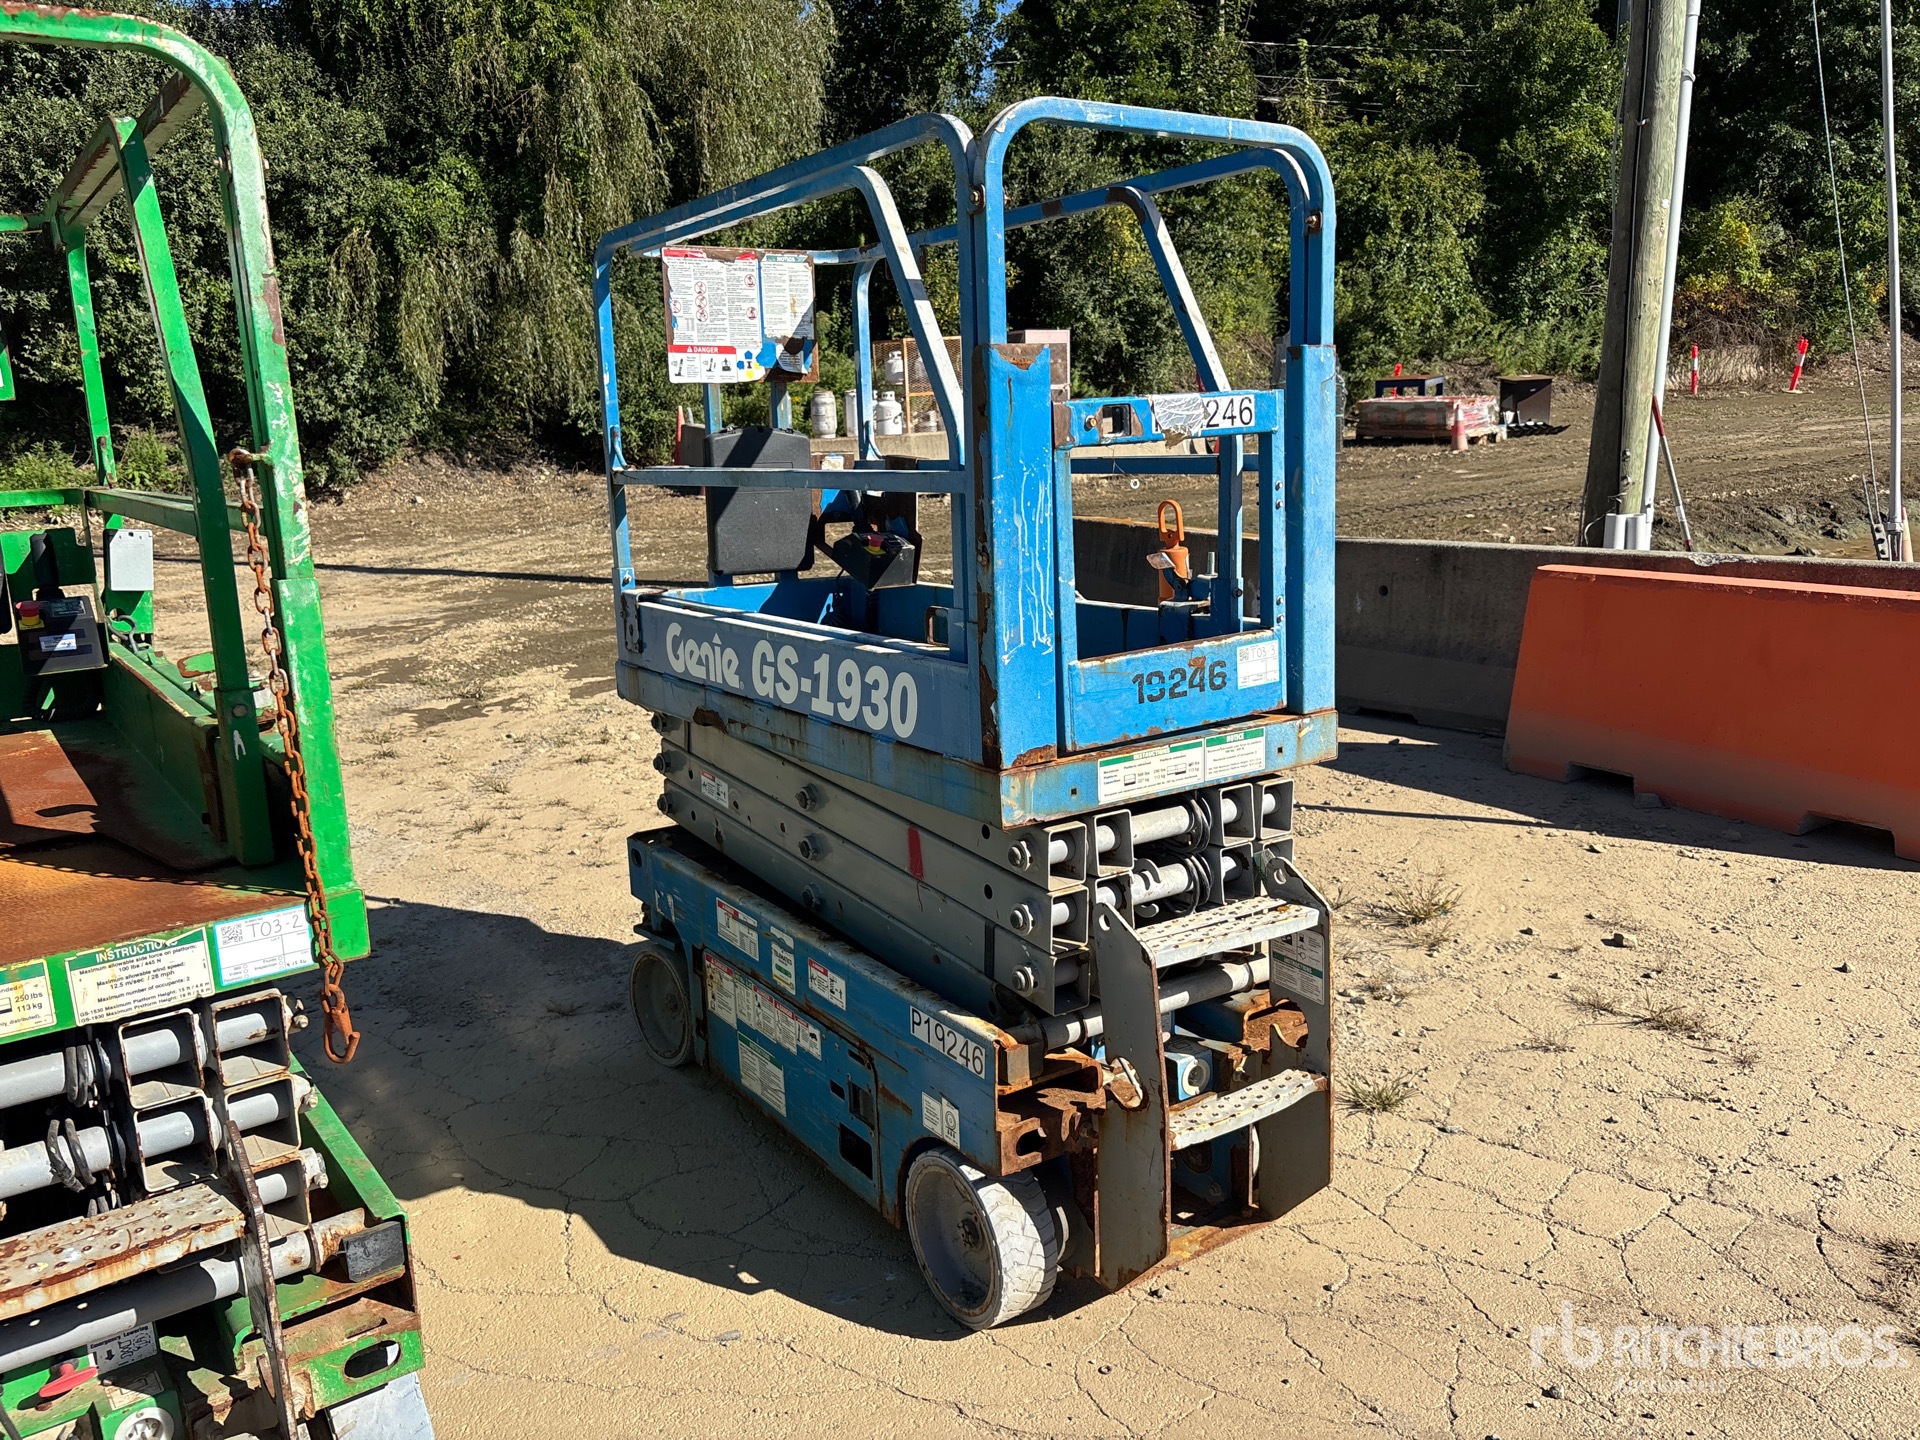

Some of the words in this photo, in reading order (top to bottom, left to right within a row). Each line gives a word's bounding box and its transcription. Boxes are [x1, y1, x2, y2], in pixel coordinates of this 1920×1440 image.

[666, 622, 740, 689] Genie
[752, 639, 918, 738] GS-1930
[1132, 660, 1227, 704] 19246
[80, 964, 106, 975] Maximum
[108, 959, 134, 968] allowable
[172, 944, 197, 954] platform:
[97, 976, 124, 986] Maximum
[125, 970, 151, 980] allowable
[152, 966, 166, 974] wind
[167, 962, 185, 971] speed:
[160, 970, 175, 978] mph
[15, 994, 29, 1002] 250
[97, 994, 124, 1003] Maximum
[126, 988, 147, 997] number
[154, 979, 185, 990] occupants:
[105, 1002, 131, 1011] Maximum
[158, 989, 178, 998] Height:
[17, 1003, 31, 1012] 113
[106, 1008, 133, 1017] Maximum
[134, 1001, 158, 1009] Platform
[159, 995, 178, 1003] Height:
[911, 1009, 984, 1076] P19246
[90, 1336, 120, 1349] Emergency
[123, 1325, 148, 1337] Lowering
